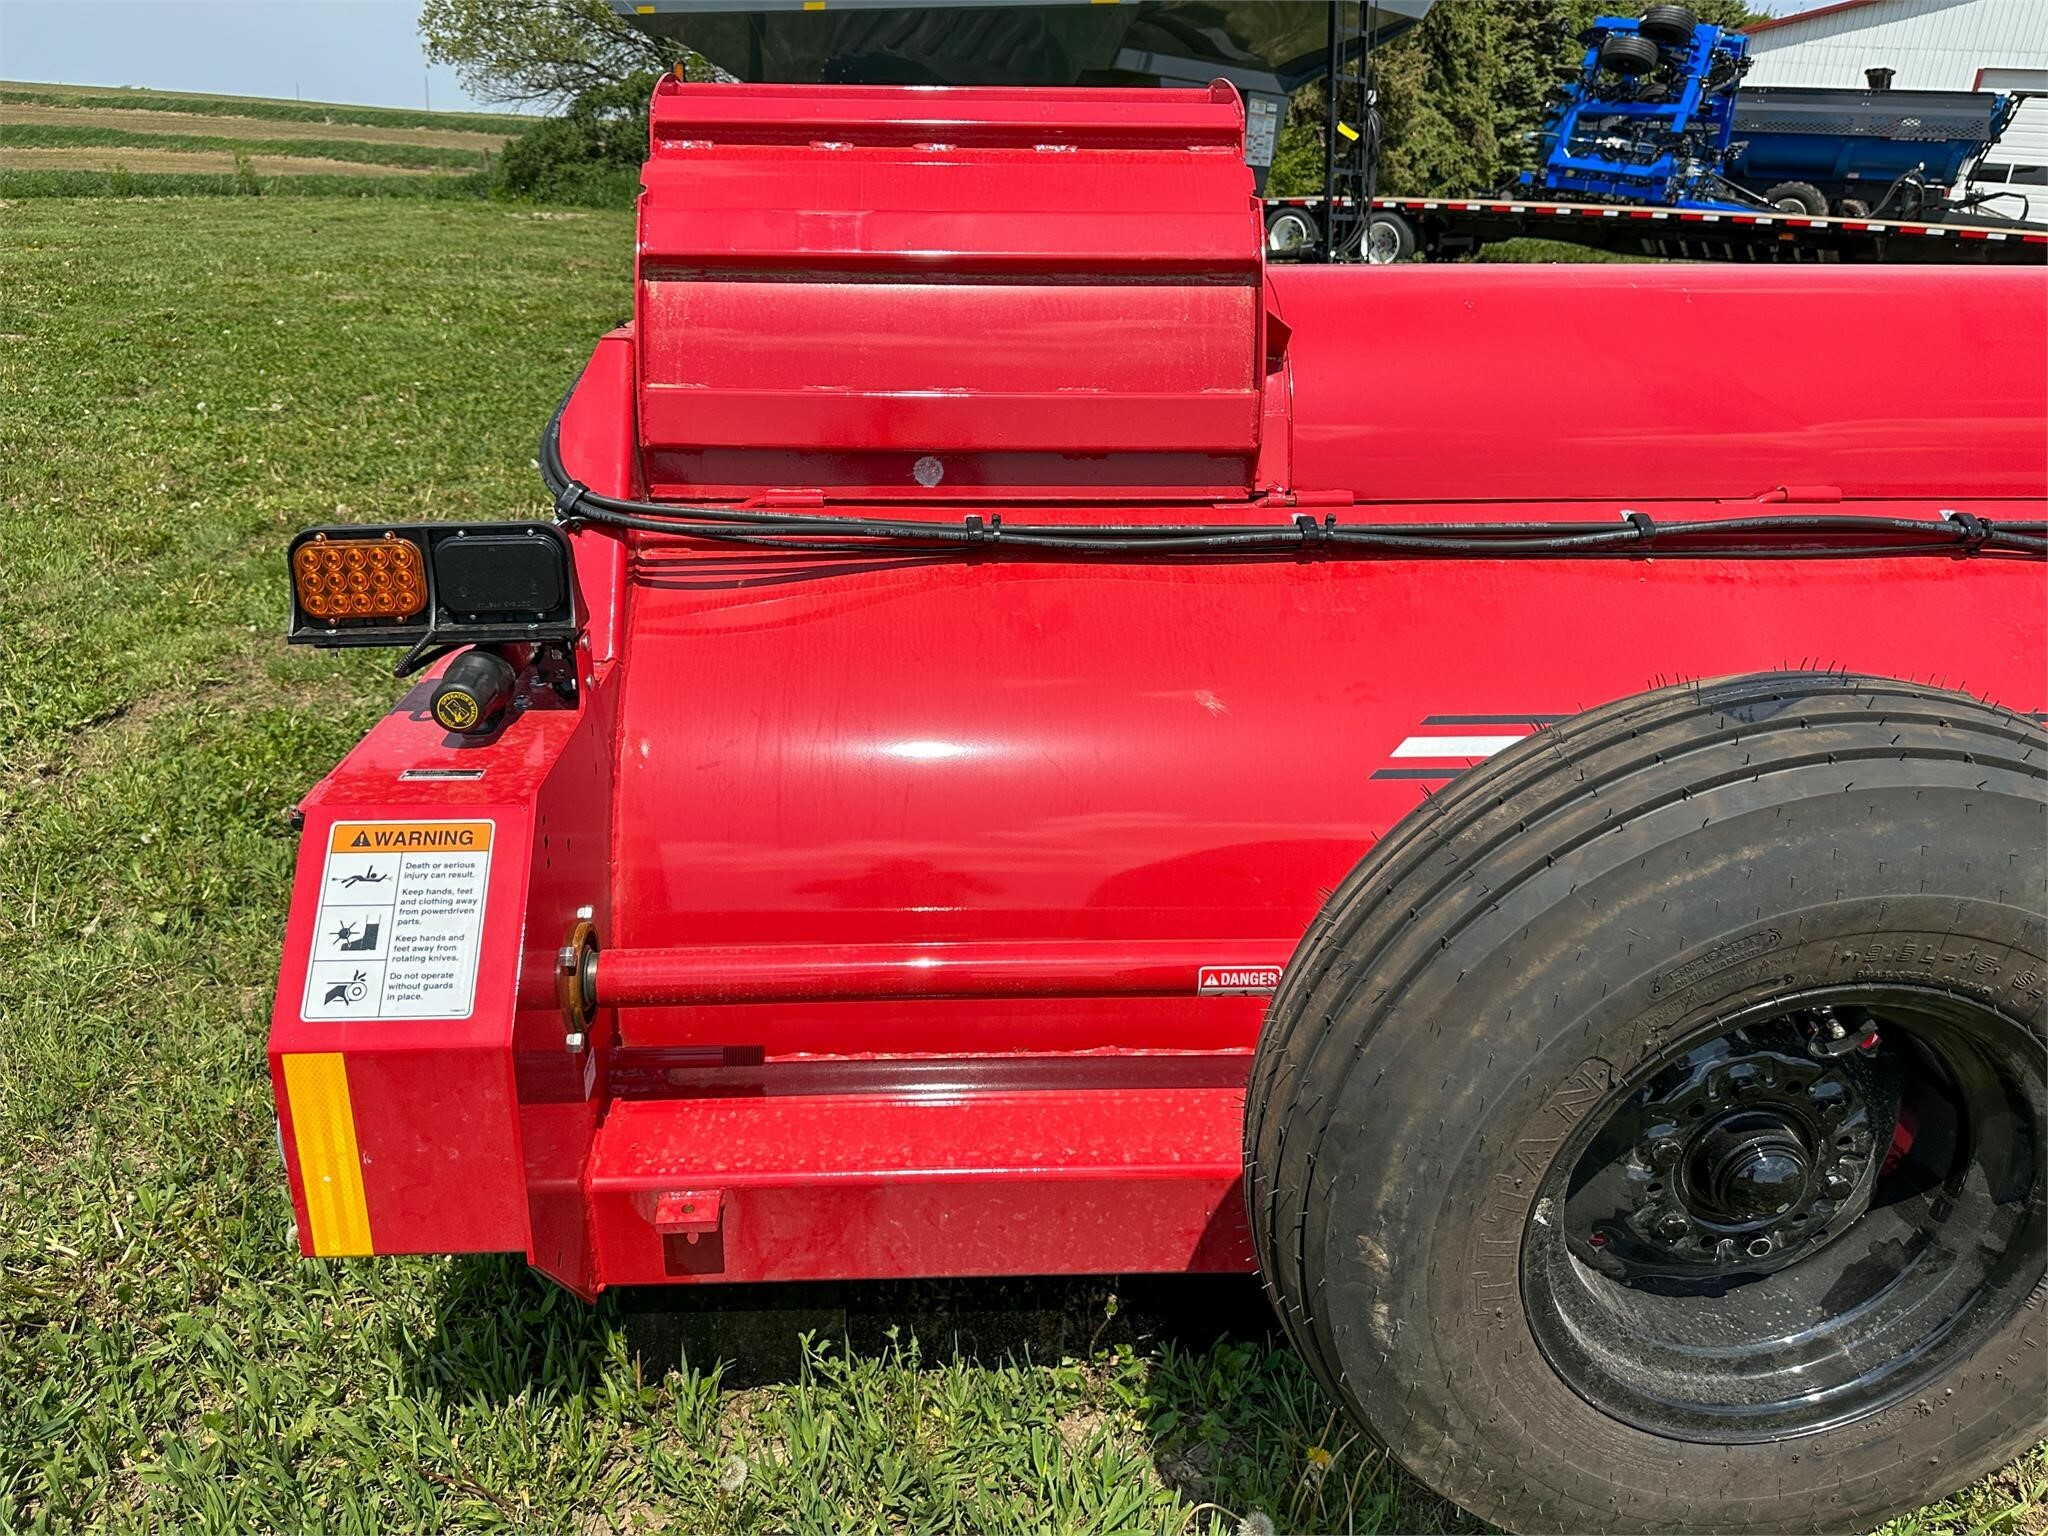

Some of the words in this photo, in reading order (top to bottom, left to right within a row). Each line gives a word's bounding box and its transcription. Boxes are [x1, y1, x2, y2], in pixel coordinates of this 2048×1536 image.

[374, 829, 474, 847] WARNING
[405, 861, 430, 869] Death
[443, 861, 476, 869] serious
[404, 871, 429, 881] injury
[448, 871, 475, 879] result.
[402, 888, 424, 897] Keep
[426, 888, 455, 896] hands,
[457, 887, 473, 895] feet
[400, 898, 417, 906] and
[418, 897, 454, 907] clothing
[455, 898, 478, 907] away
[399, 908, 419, 916] from
[421, 907, 475, 917] powerdriven
[397, 918, 422, 928] parts.
[395, 934, 418, 943] Keep
[419, 934, 446, 942] hands
[411, 945, 435, 954] away
[391, 955, 426, 964] rotating
[428, 954, 460, 962] knives.
[389, 972, 402, 980] Do
[404, 972, 419, 980] not
[420, 972, 455, 981] operate
[1220, 972, 1277, 986] DANGER
[388, 982, 421, 990] without
[423, 982, 454, 991] guards
[397, 993, 424, 1003] place.
[1471, 1060, 1608, 1317] TITAN
